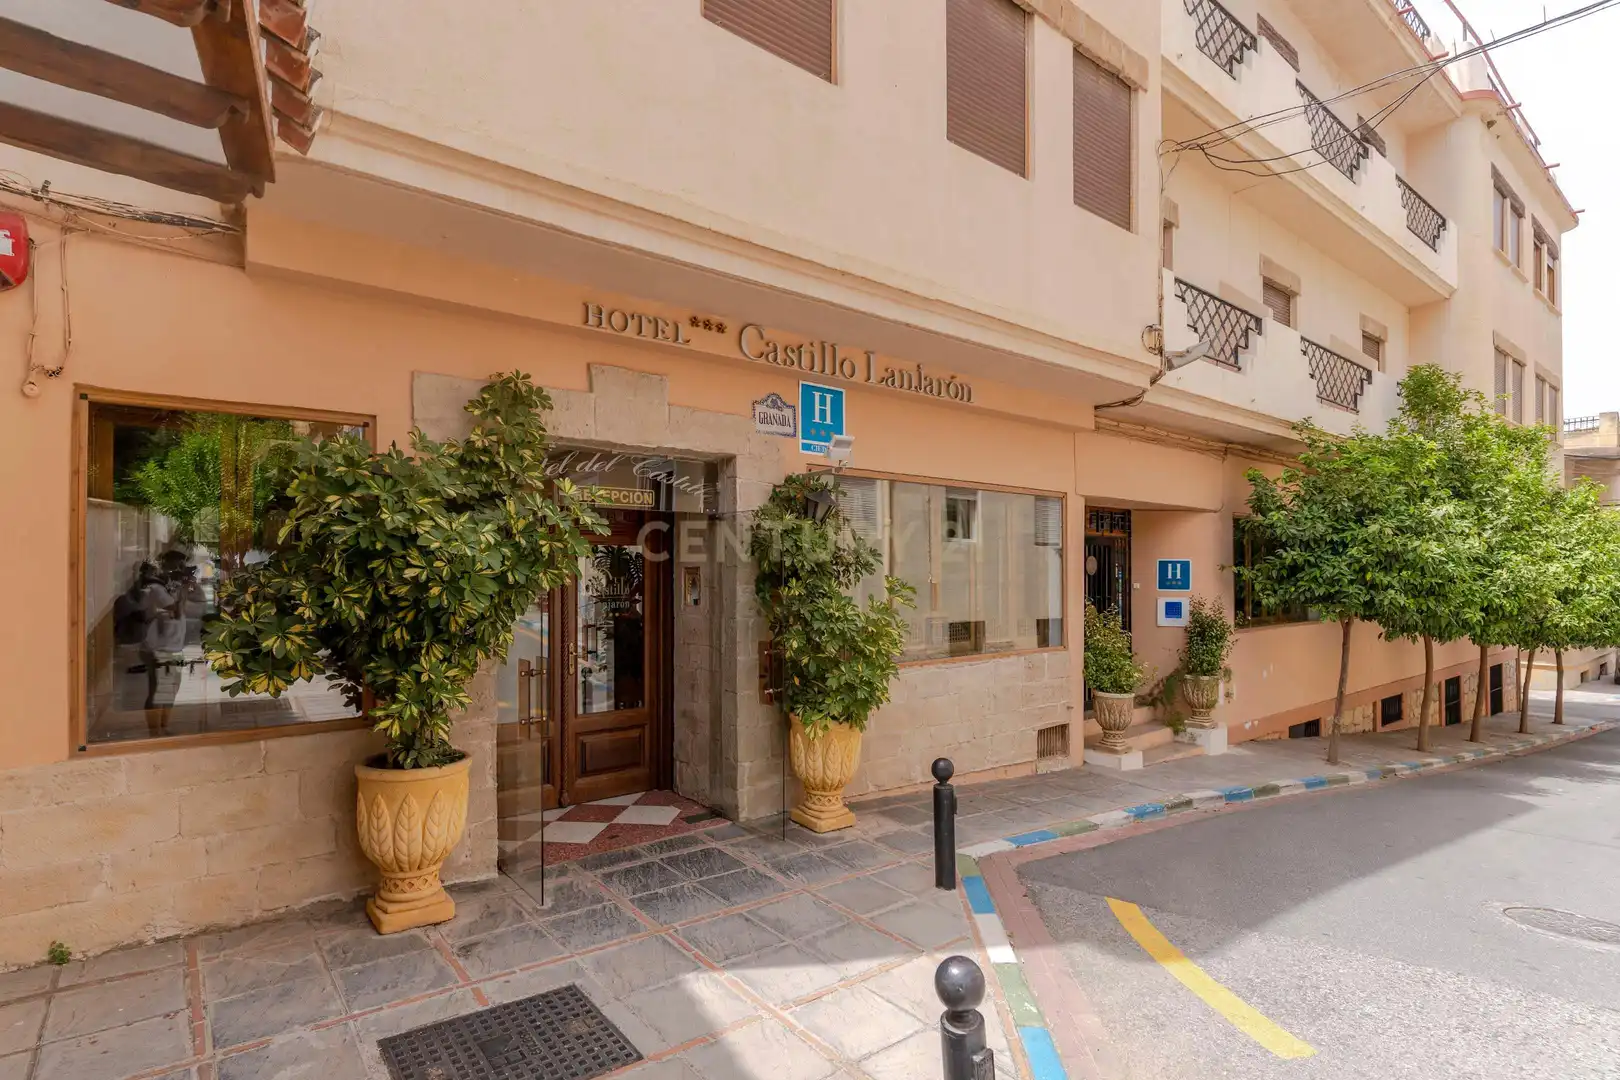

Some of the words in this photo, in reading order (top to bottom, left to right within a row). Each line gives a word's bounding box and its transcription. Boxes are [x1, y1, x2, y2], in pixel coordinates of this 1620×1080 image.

[583, 302, 691, 345] HOTEL
[739, 323, 856, 380] Castillo
[864, 350, 974, 404] Lanjarón
[812, 391, 833, 425] H
[758, 411, 791, 428] GRANADA
[575, 452, 626, 473] del
[1167, 563, 1181, 579] H
